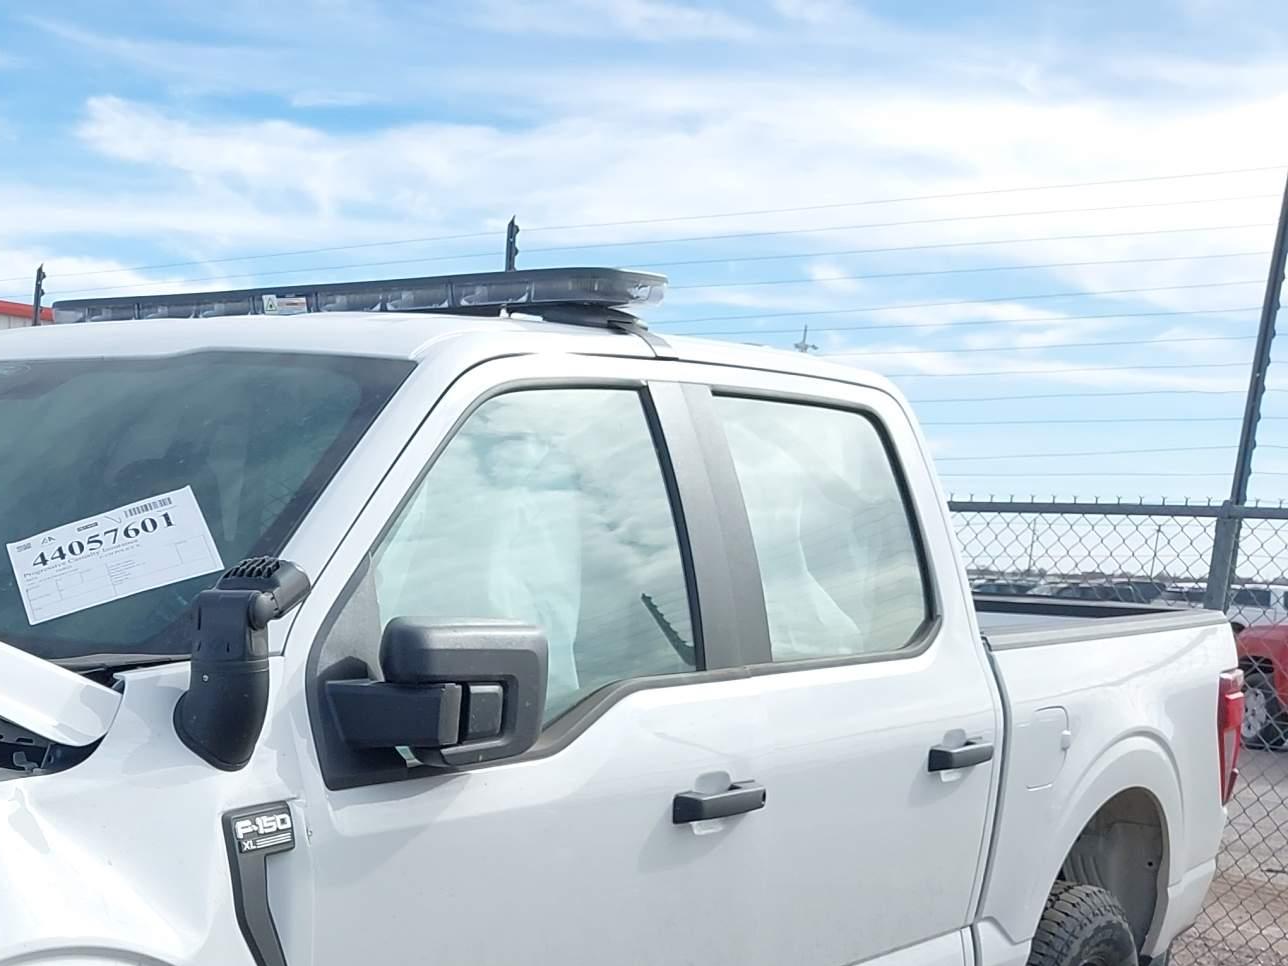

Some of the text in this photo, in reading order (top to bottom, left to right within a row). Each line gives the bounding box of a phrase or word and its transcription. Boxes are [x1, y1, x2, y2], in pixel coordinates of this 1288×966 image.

[31, 511, 176, 568] 44057601
[234, 813, 292, 838] F-150
[242, 840, 257, 852] XL
